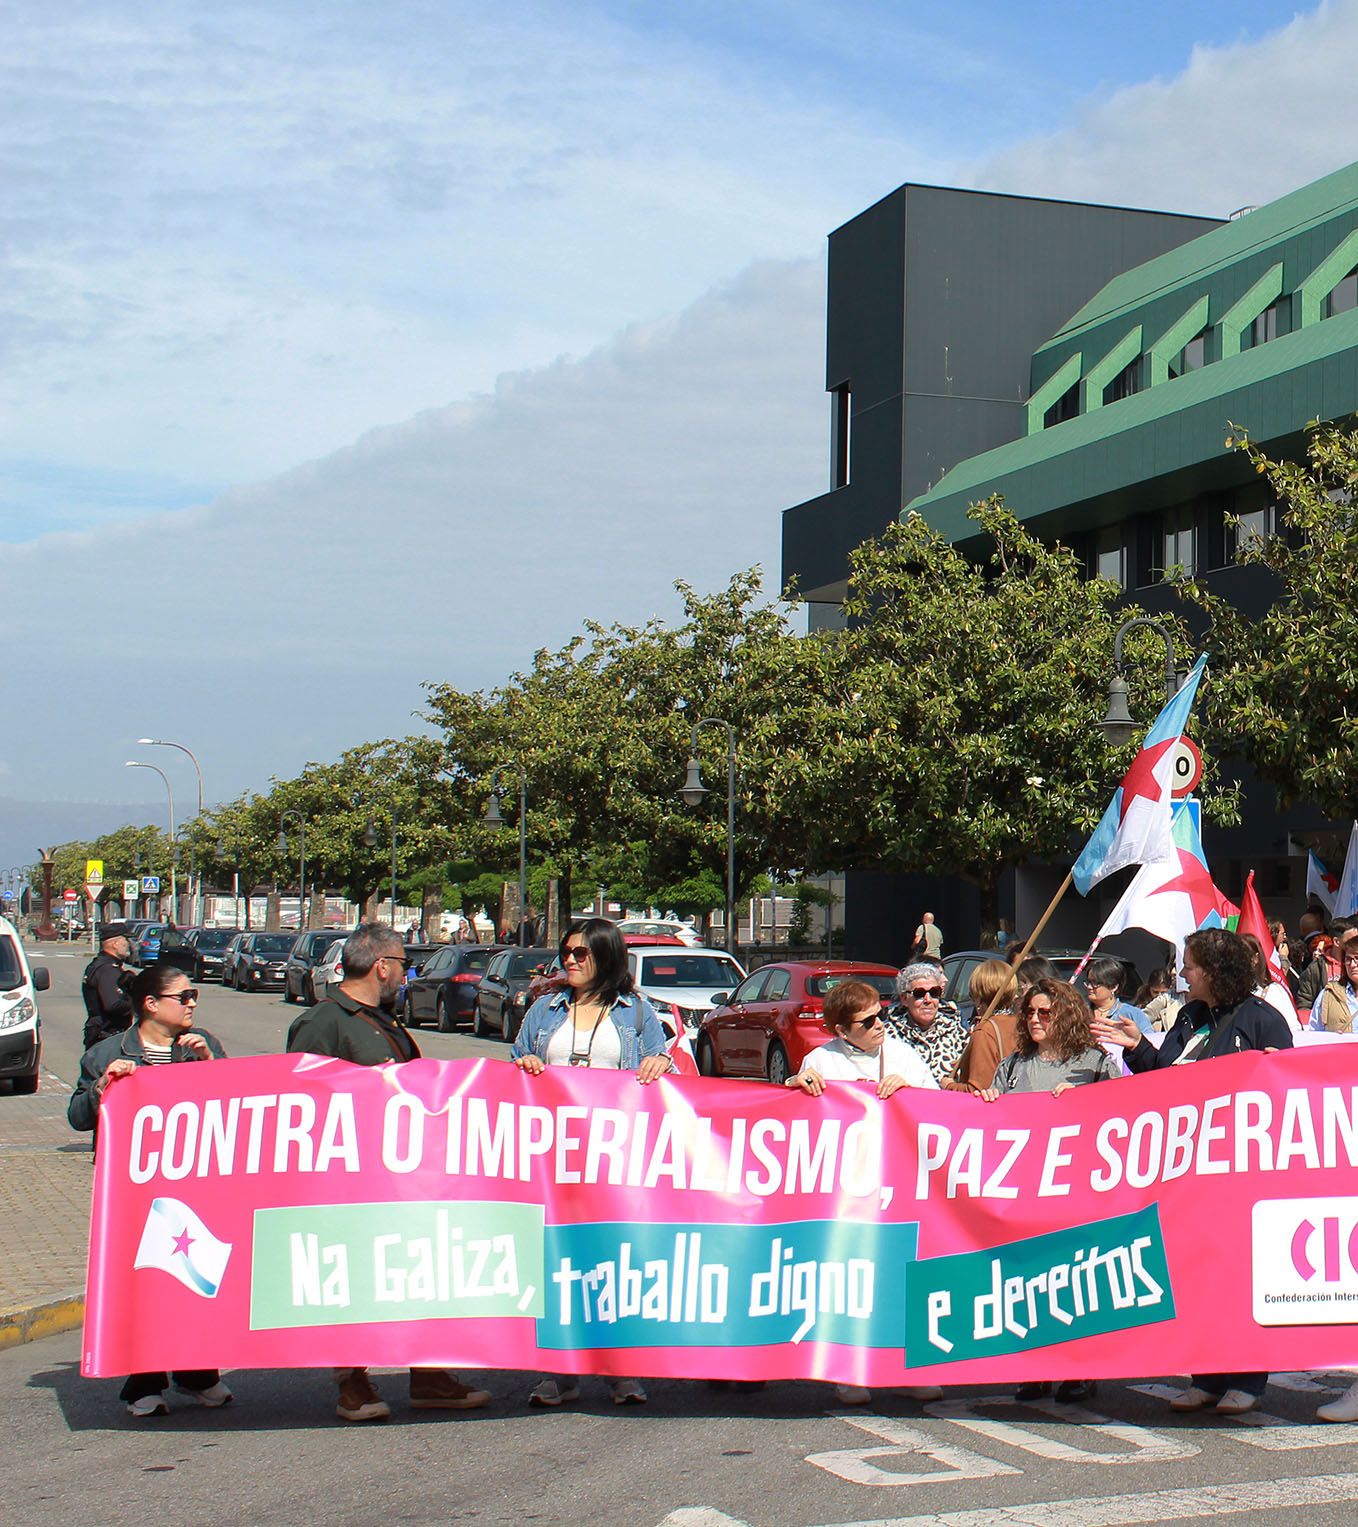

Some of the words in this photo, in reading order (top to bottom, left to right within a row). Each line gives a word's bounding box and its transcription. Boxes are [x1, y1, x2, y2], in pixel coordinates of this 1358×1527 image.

[128, 1091, 361, 1185] CONTRA
[381, 1091, 425, 1175] O
[444, 1095, 894, 1211] IMPERIALISMO,
[915, 1122, 1031, 1200] PAZ
[1037, 1123, 1082, 1197] E
[289, 1231, 351, 1309] Na
[373, 1208, 536, 1312] Galiza,
[552, 1231, 729, 1326] traballo
[748, 1237, 876, 1345] digno
[927, 1289, 955, 1353] e
[973, 1235, 1162, 1339] dereitos
[1264, 1292, 1332, 1304] Confederación
